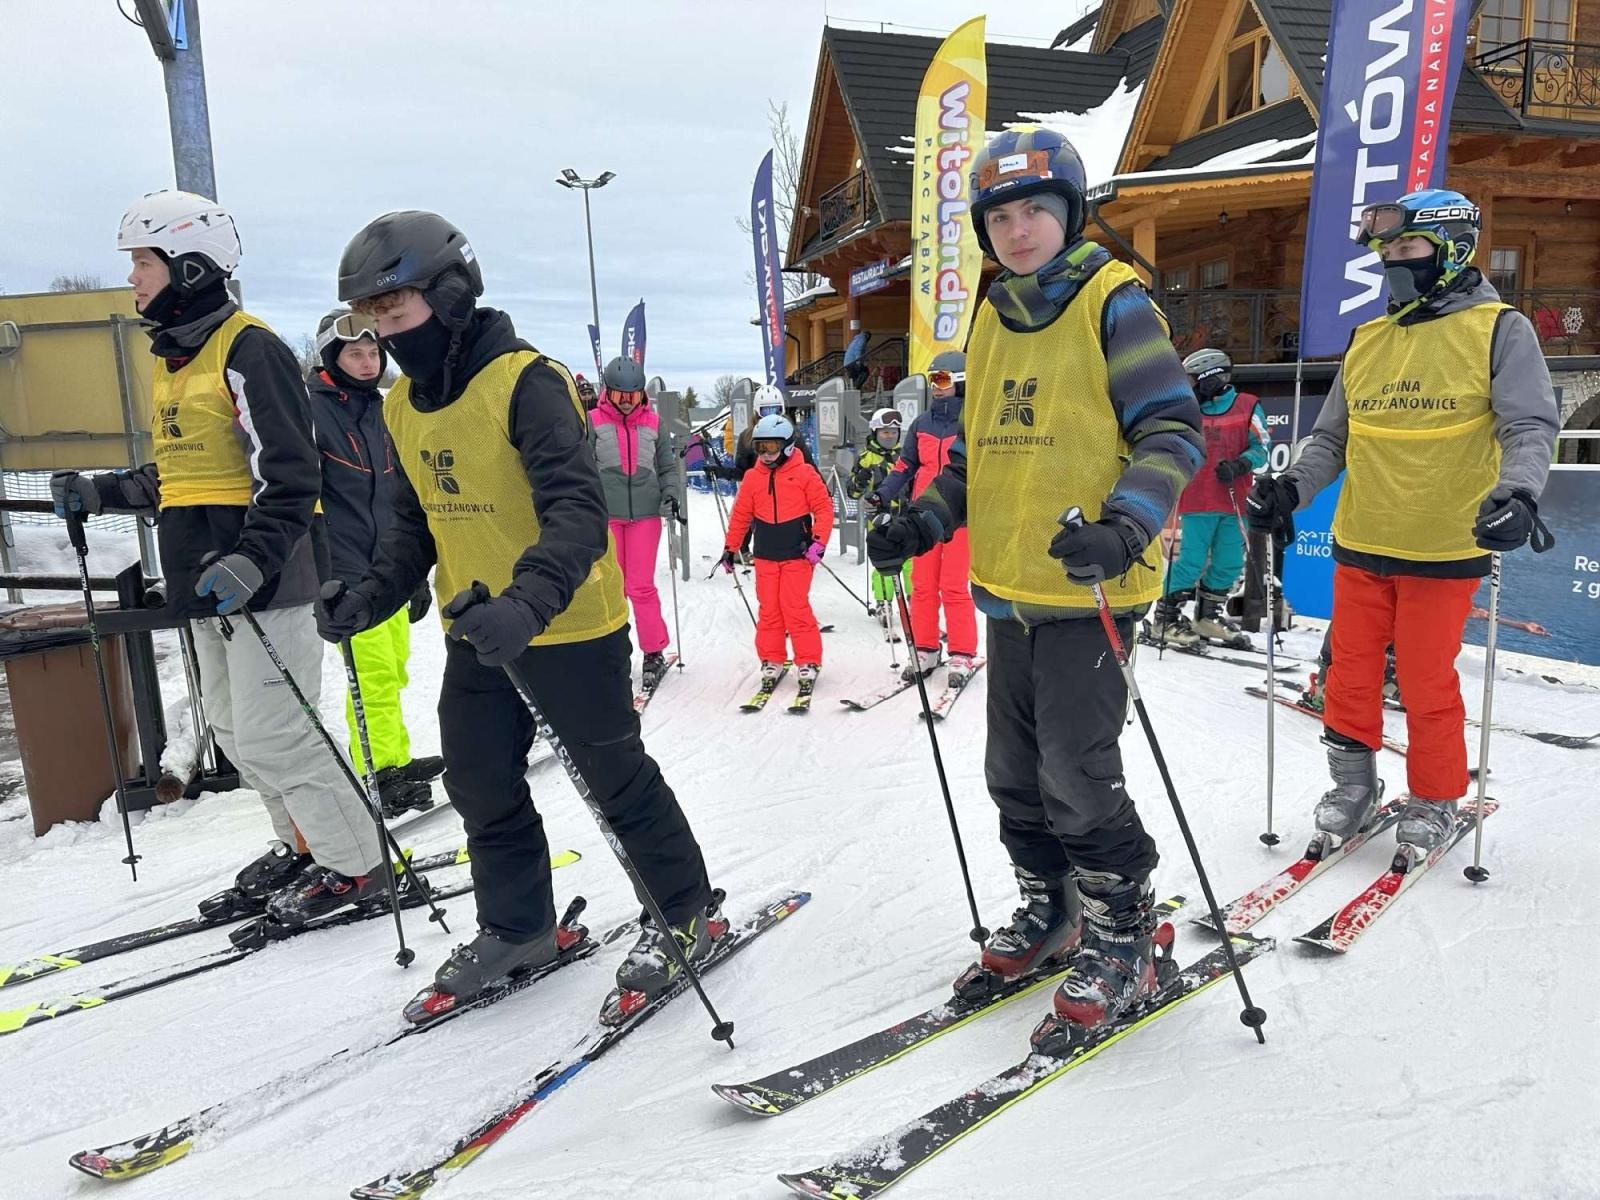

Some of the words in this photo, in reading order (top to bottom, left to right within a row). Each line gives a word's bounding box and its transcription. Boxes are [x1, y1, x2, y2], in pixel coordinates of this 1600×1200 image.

[1415, 101, 1437, 191] STACJA
[1339, 0, 1413, 315] WTÓW
[922, 137, 932, 198] PLAC
[920, 214, 931, 295] ZABAW
[376, 274, 397, 286] GIRO
[1197, 367, 1225, 380] ALPINA
[1487, 511, 1513, 528] VIKING
[1296, 543, 1331, 558] BUKO
[1572, 580, 1582, 593] z
